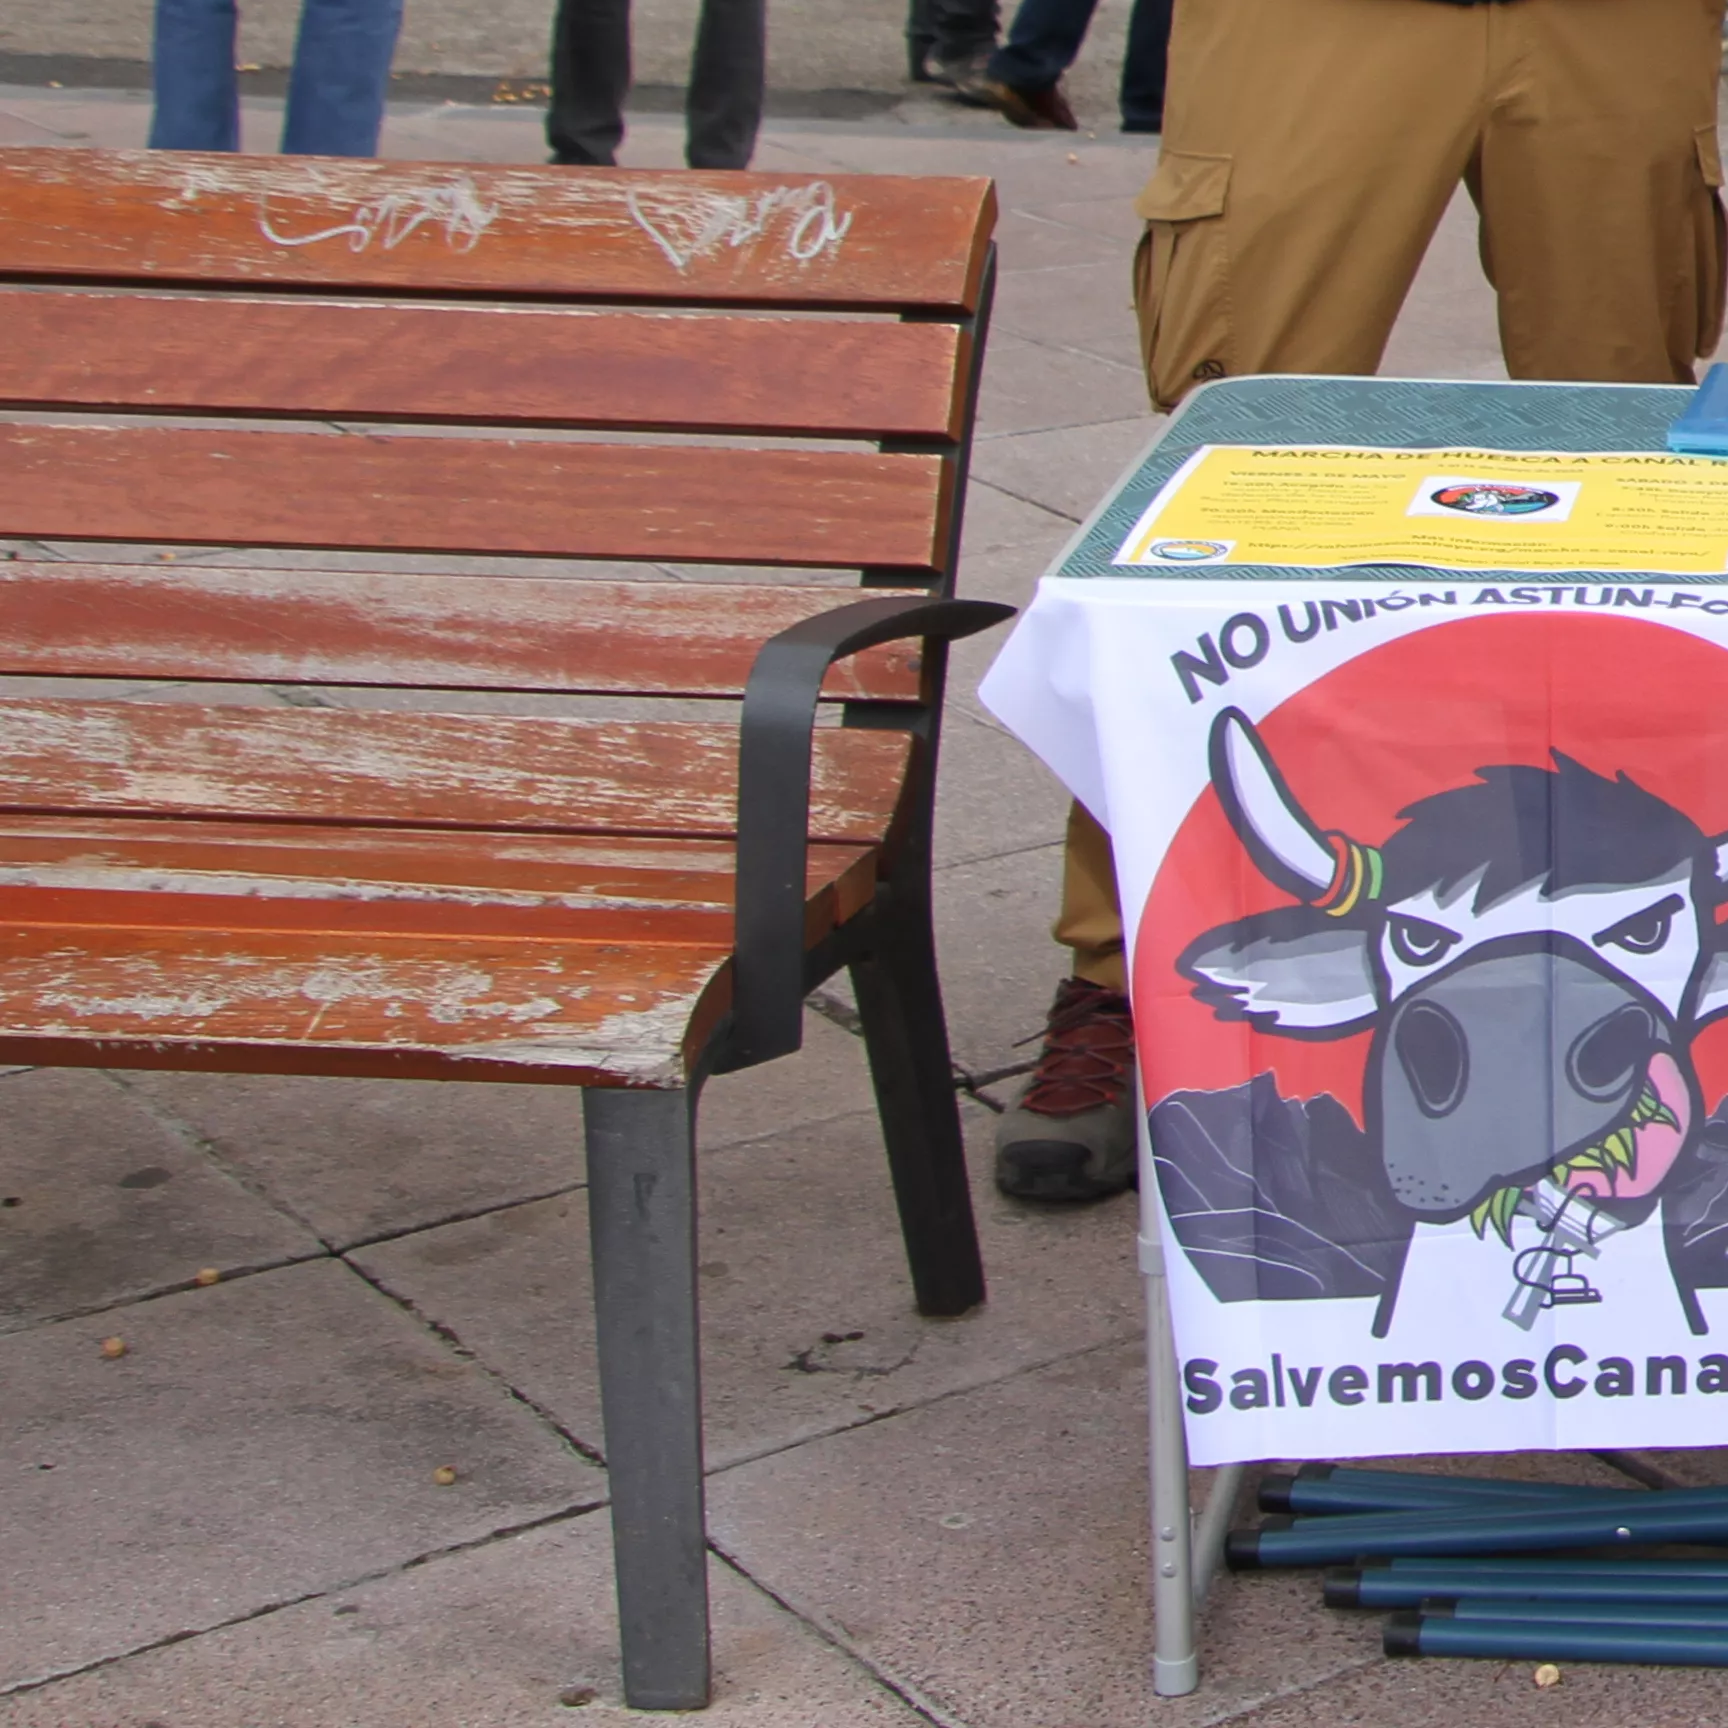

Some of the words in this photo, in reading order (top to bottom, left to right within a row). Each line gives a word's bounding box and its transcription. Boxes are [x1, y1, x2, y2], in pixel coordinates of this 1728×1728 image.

[1252, 450, 1385, 461] MARCHA
[1395, 452, 1432, 461] DE
[1441, 452, 1563, 464] HUESCA
[1571, 456, 1591, 464] A
[1600, 457, 1701, 467] CANAL
[1170, 611, 1270, 705] NO
[1276, 589, 1457, 643] UNIÓN
